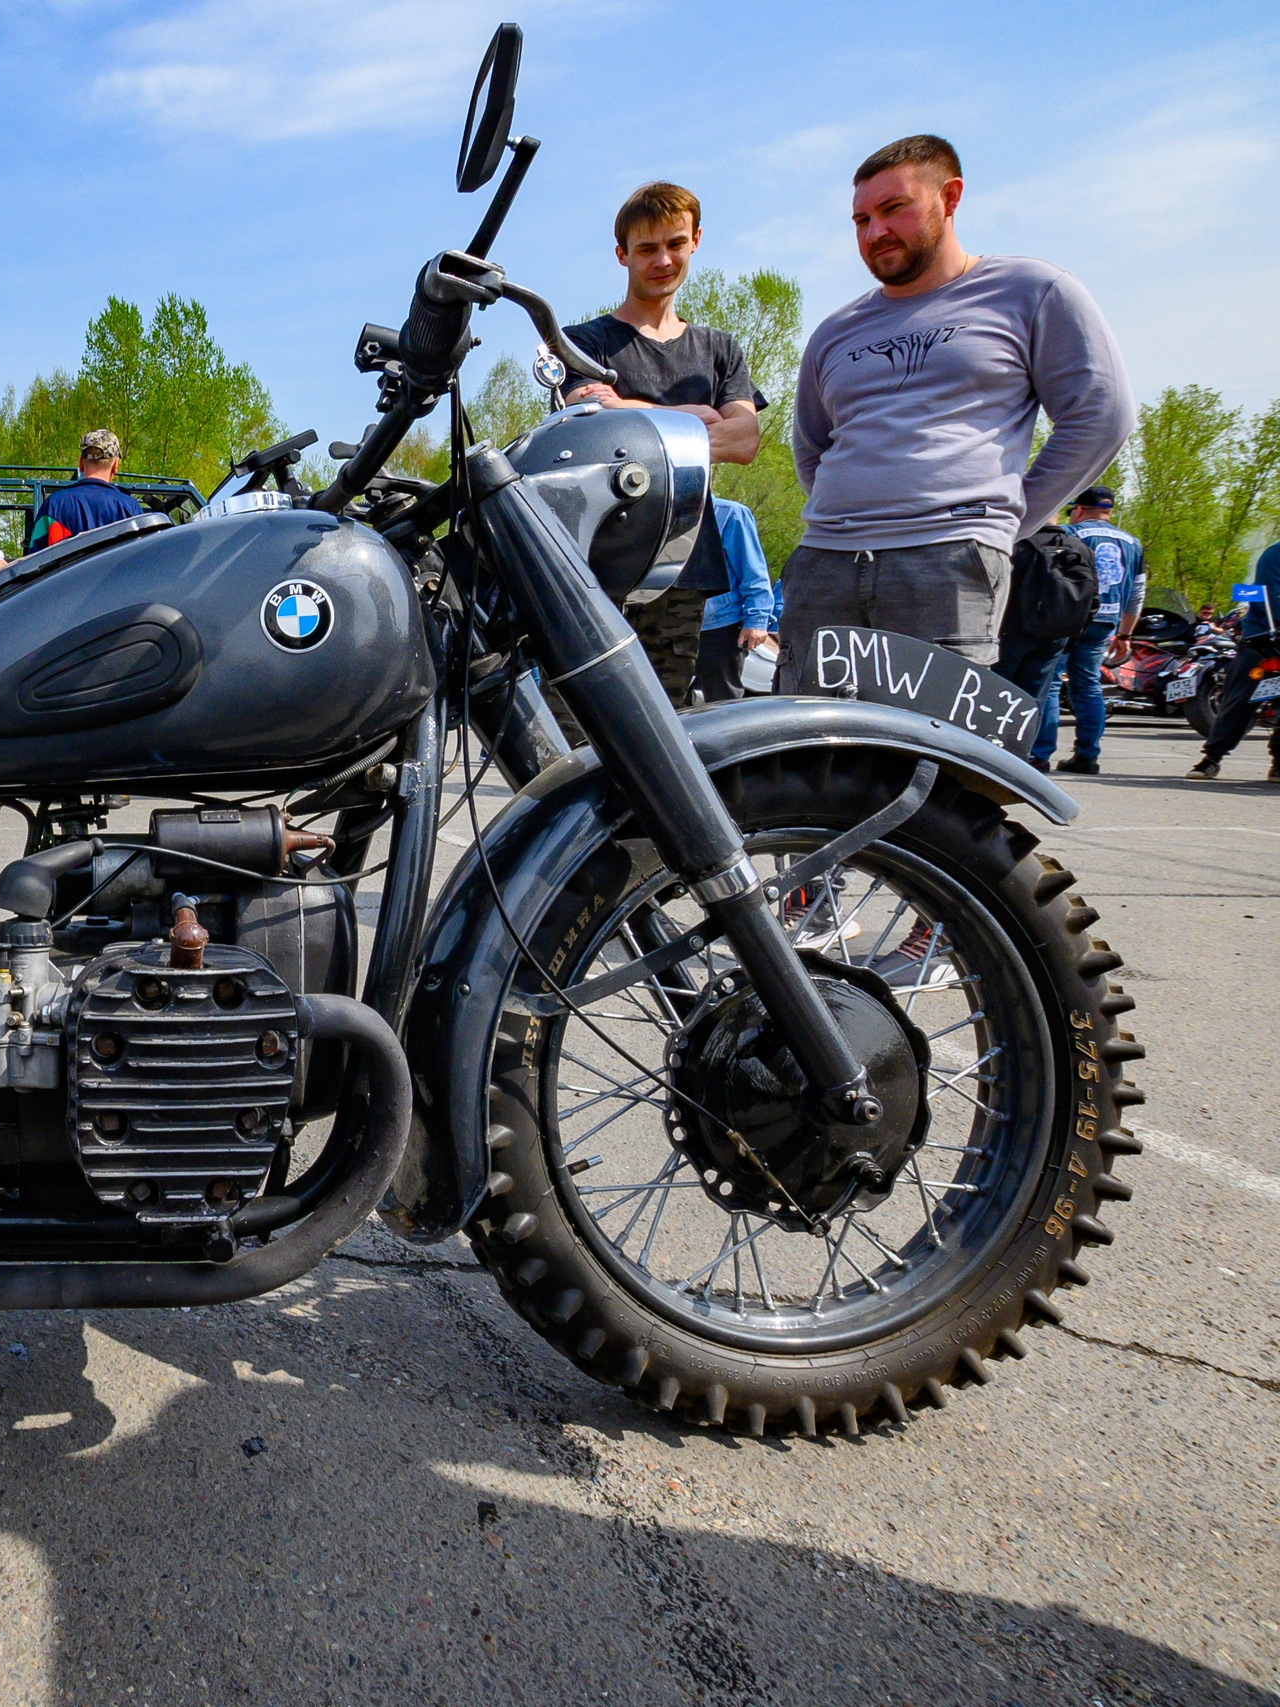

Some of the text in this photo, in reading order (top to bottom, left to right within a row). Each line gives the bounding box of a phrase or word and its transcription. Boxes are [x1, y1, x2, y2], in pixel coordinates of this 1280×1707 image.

[847, 324, 969, 380] TERMIT
[269, 584, 326, 607] BMW
[817, 630, 1038, 741] BMW R-71
